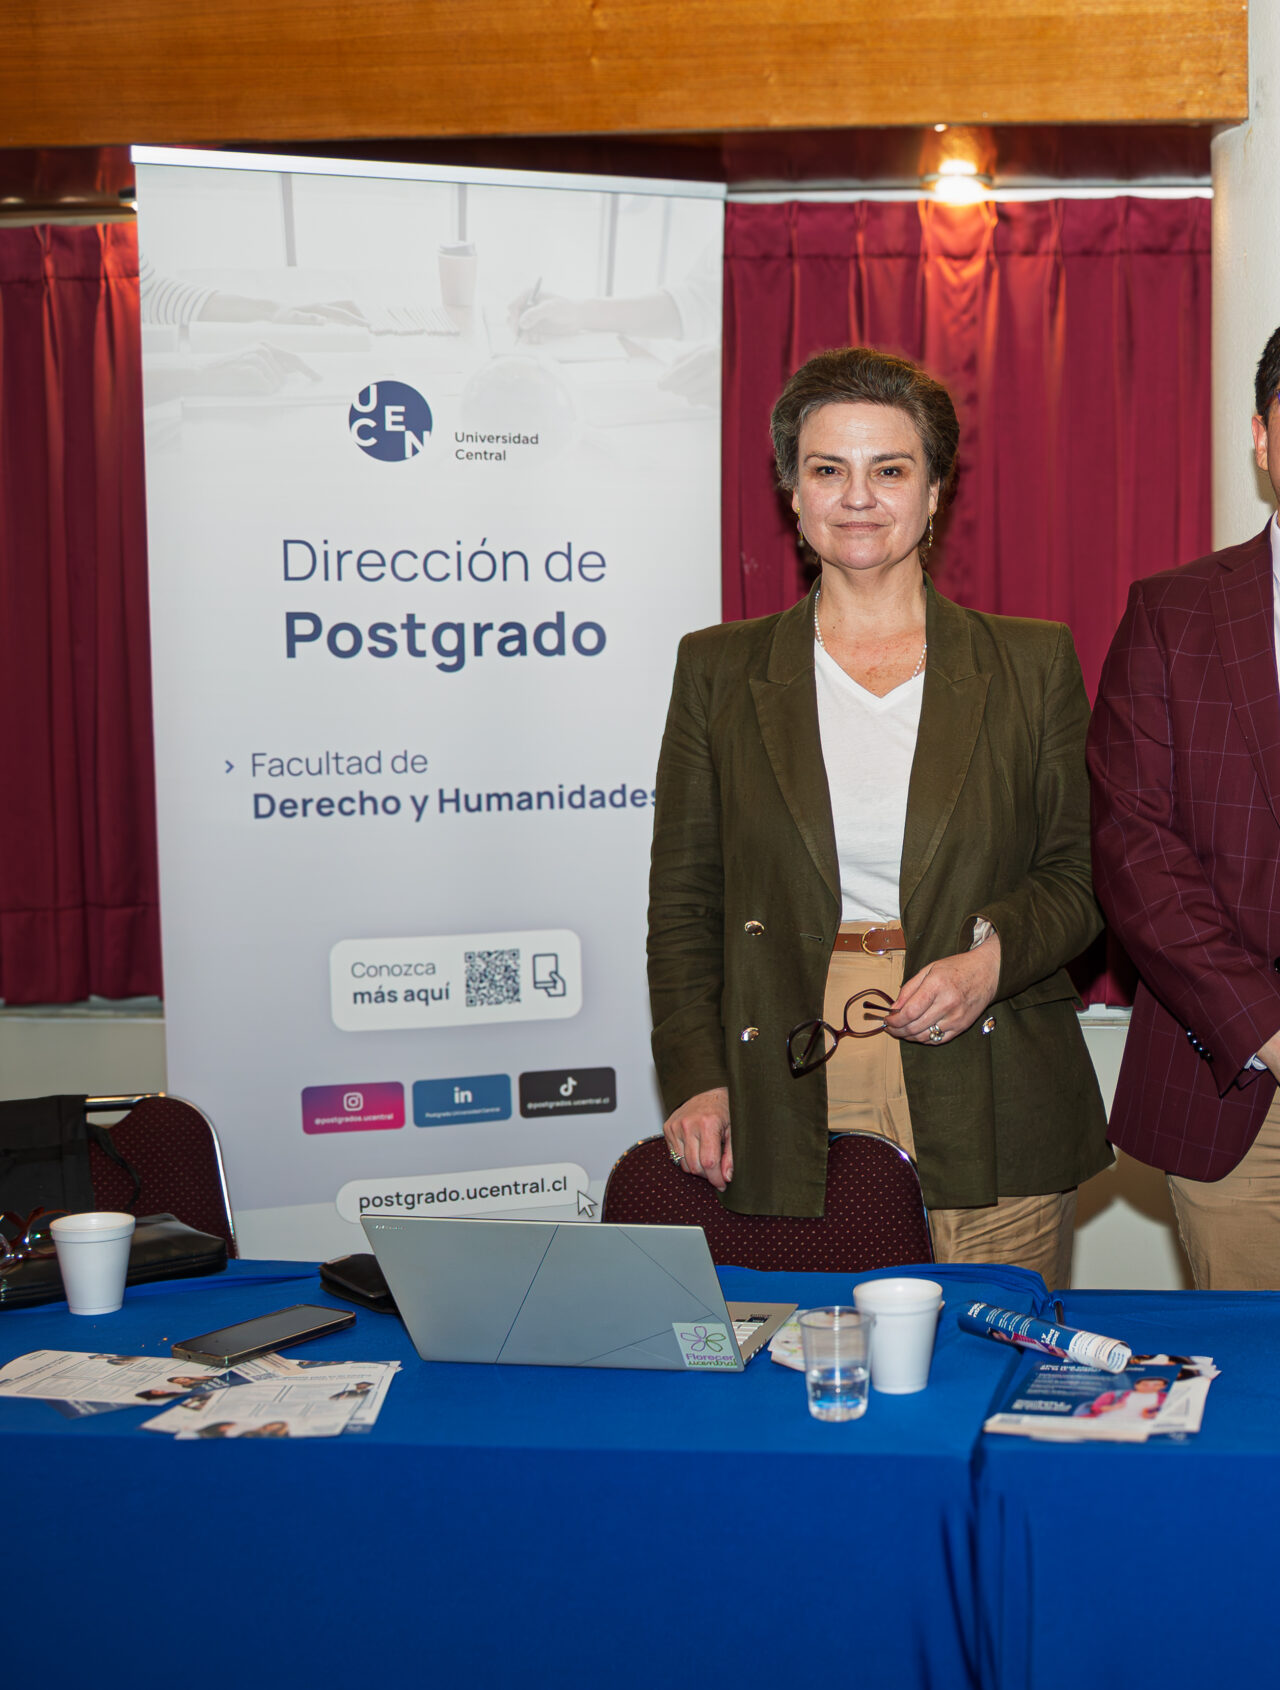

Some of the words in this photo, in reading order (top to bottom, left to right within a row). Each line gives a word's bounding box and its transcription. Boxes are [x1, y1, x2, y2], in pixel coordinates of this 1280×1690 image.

[454, 431, 540, 445] Universidad
[454, 448, 507, 461] Central
[283, 537, 530, 583] Dirección
[544, 541, 608, 583] de
[284, 610, 608, 674] Postgrado
[251, 750, 382, 777] Facultad
[390, 750, 429, 774] de
[253, 791, 401, 819] Derecho
[410, 794, 430, 822] y
[350, 961, 436, 979] Conozca
[352, 985, 398, 1005] más
[403, 981, 451, 1006] aquí
[358, 1175, 568, 1214] postgrado.ucentral.cl
